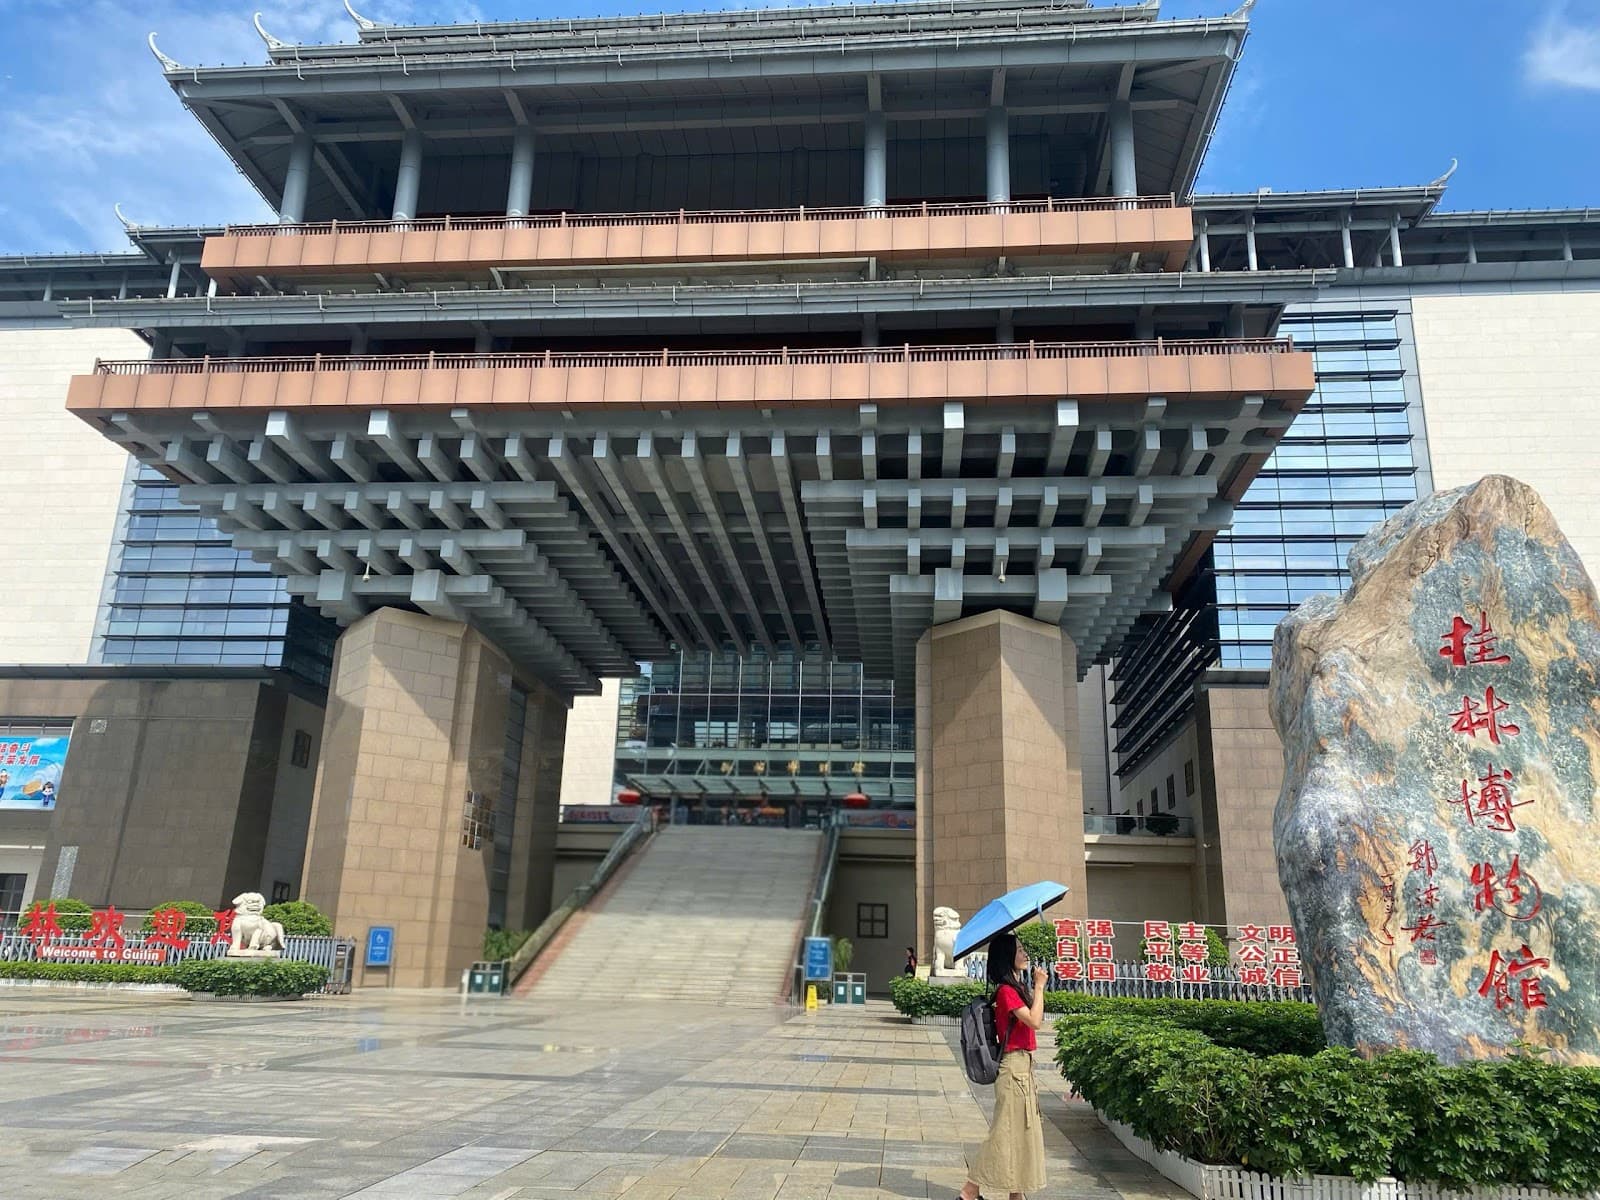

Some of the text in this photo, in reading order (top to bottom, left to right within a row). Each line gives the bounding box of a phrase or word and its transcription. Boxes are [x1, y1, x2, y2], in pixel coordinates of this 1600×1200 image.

[0, 902, 247, 950] 林欢迎
[1053, 918, 1296, 945] 富强 民主 文明
[42, 946, 159, 961] Welcome to Guilin
[1055, 939, 1301, 965] 自由 平等 公正
[1054, 961, 1302, 988] 爱国 敬业 诚信
